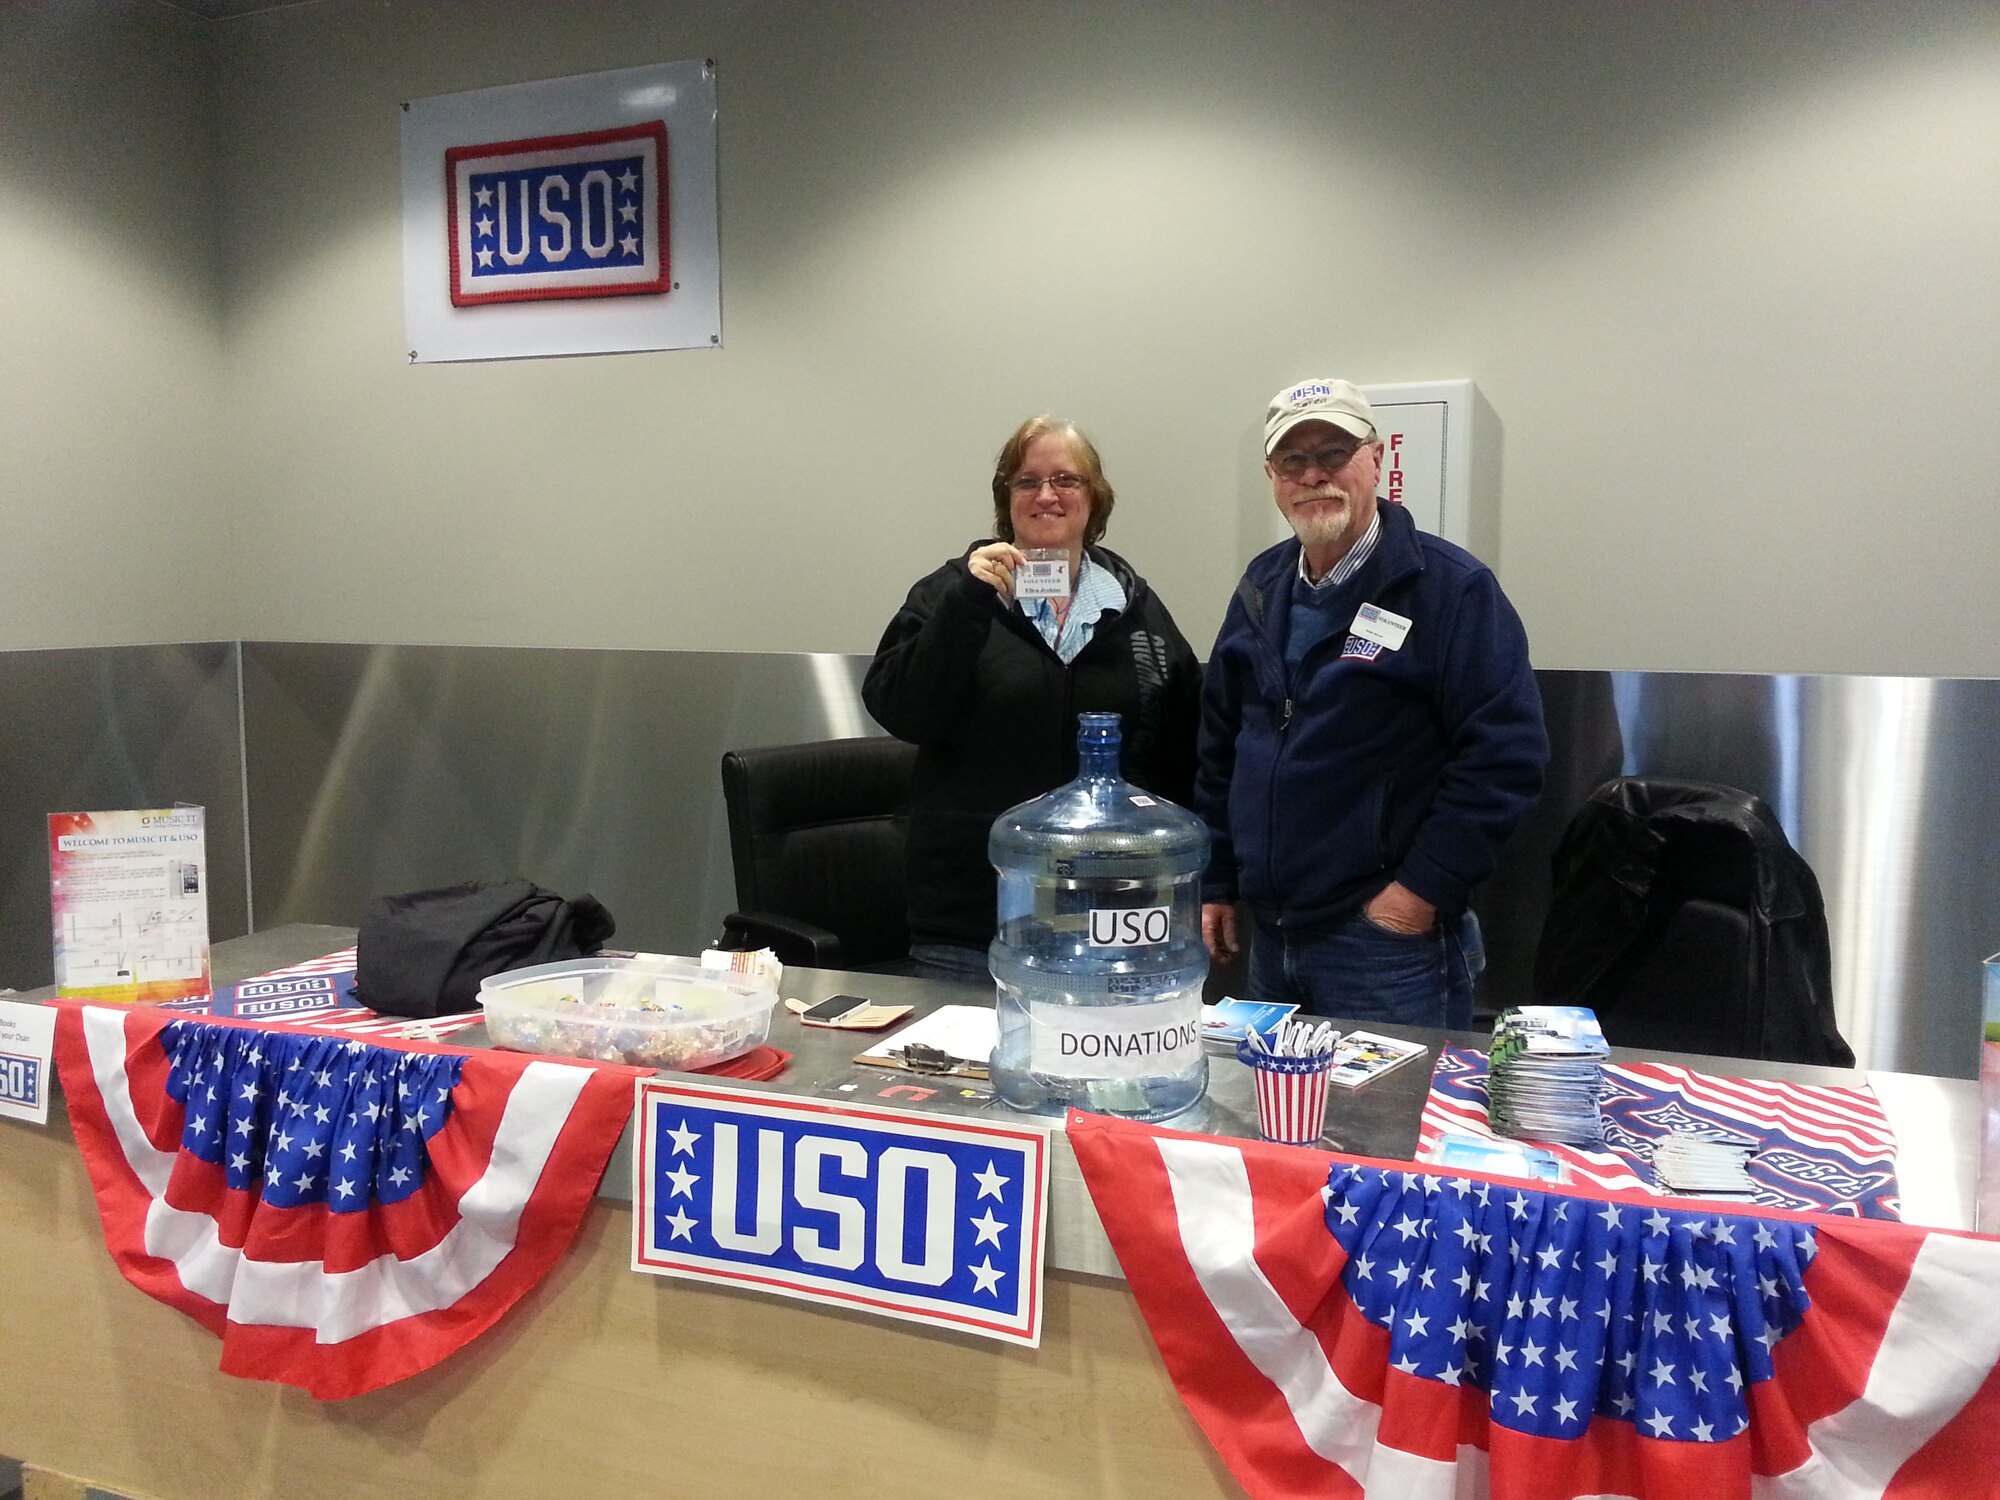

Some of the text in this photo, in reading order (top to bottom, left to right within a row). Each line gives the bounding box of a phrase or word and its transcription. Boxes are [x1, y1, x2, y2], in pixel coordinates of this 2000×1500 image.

[498, 169, 615, 266] USO
[1294, 384, 1324, 400] USO
[1388, 433, 1404, 505] FIRE
[1378, 616, 1407, 631] VOLUNTEER
[1347, 638, 1372, 655] USO
[153, 815, 184, 824] MUSIC
[187, 815, 197, 823] IT
[63, 838, 108, 847] WELCOME
[127, 835, 157, 844] MUSIC
[179, 834, 199, 842] USO
[1092, 909, 1169, 945] USO
[260, 998, 314, 1011] USO
[1061, 1020, 1197, 1058] DONATIONS
[711, 1122, 957, 1287] USO
